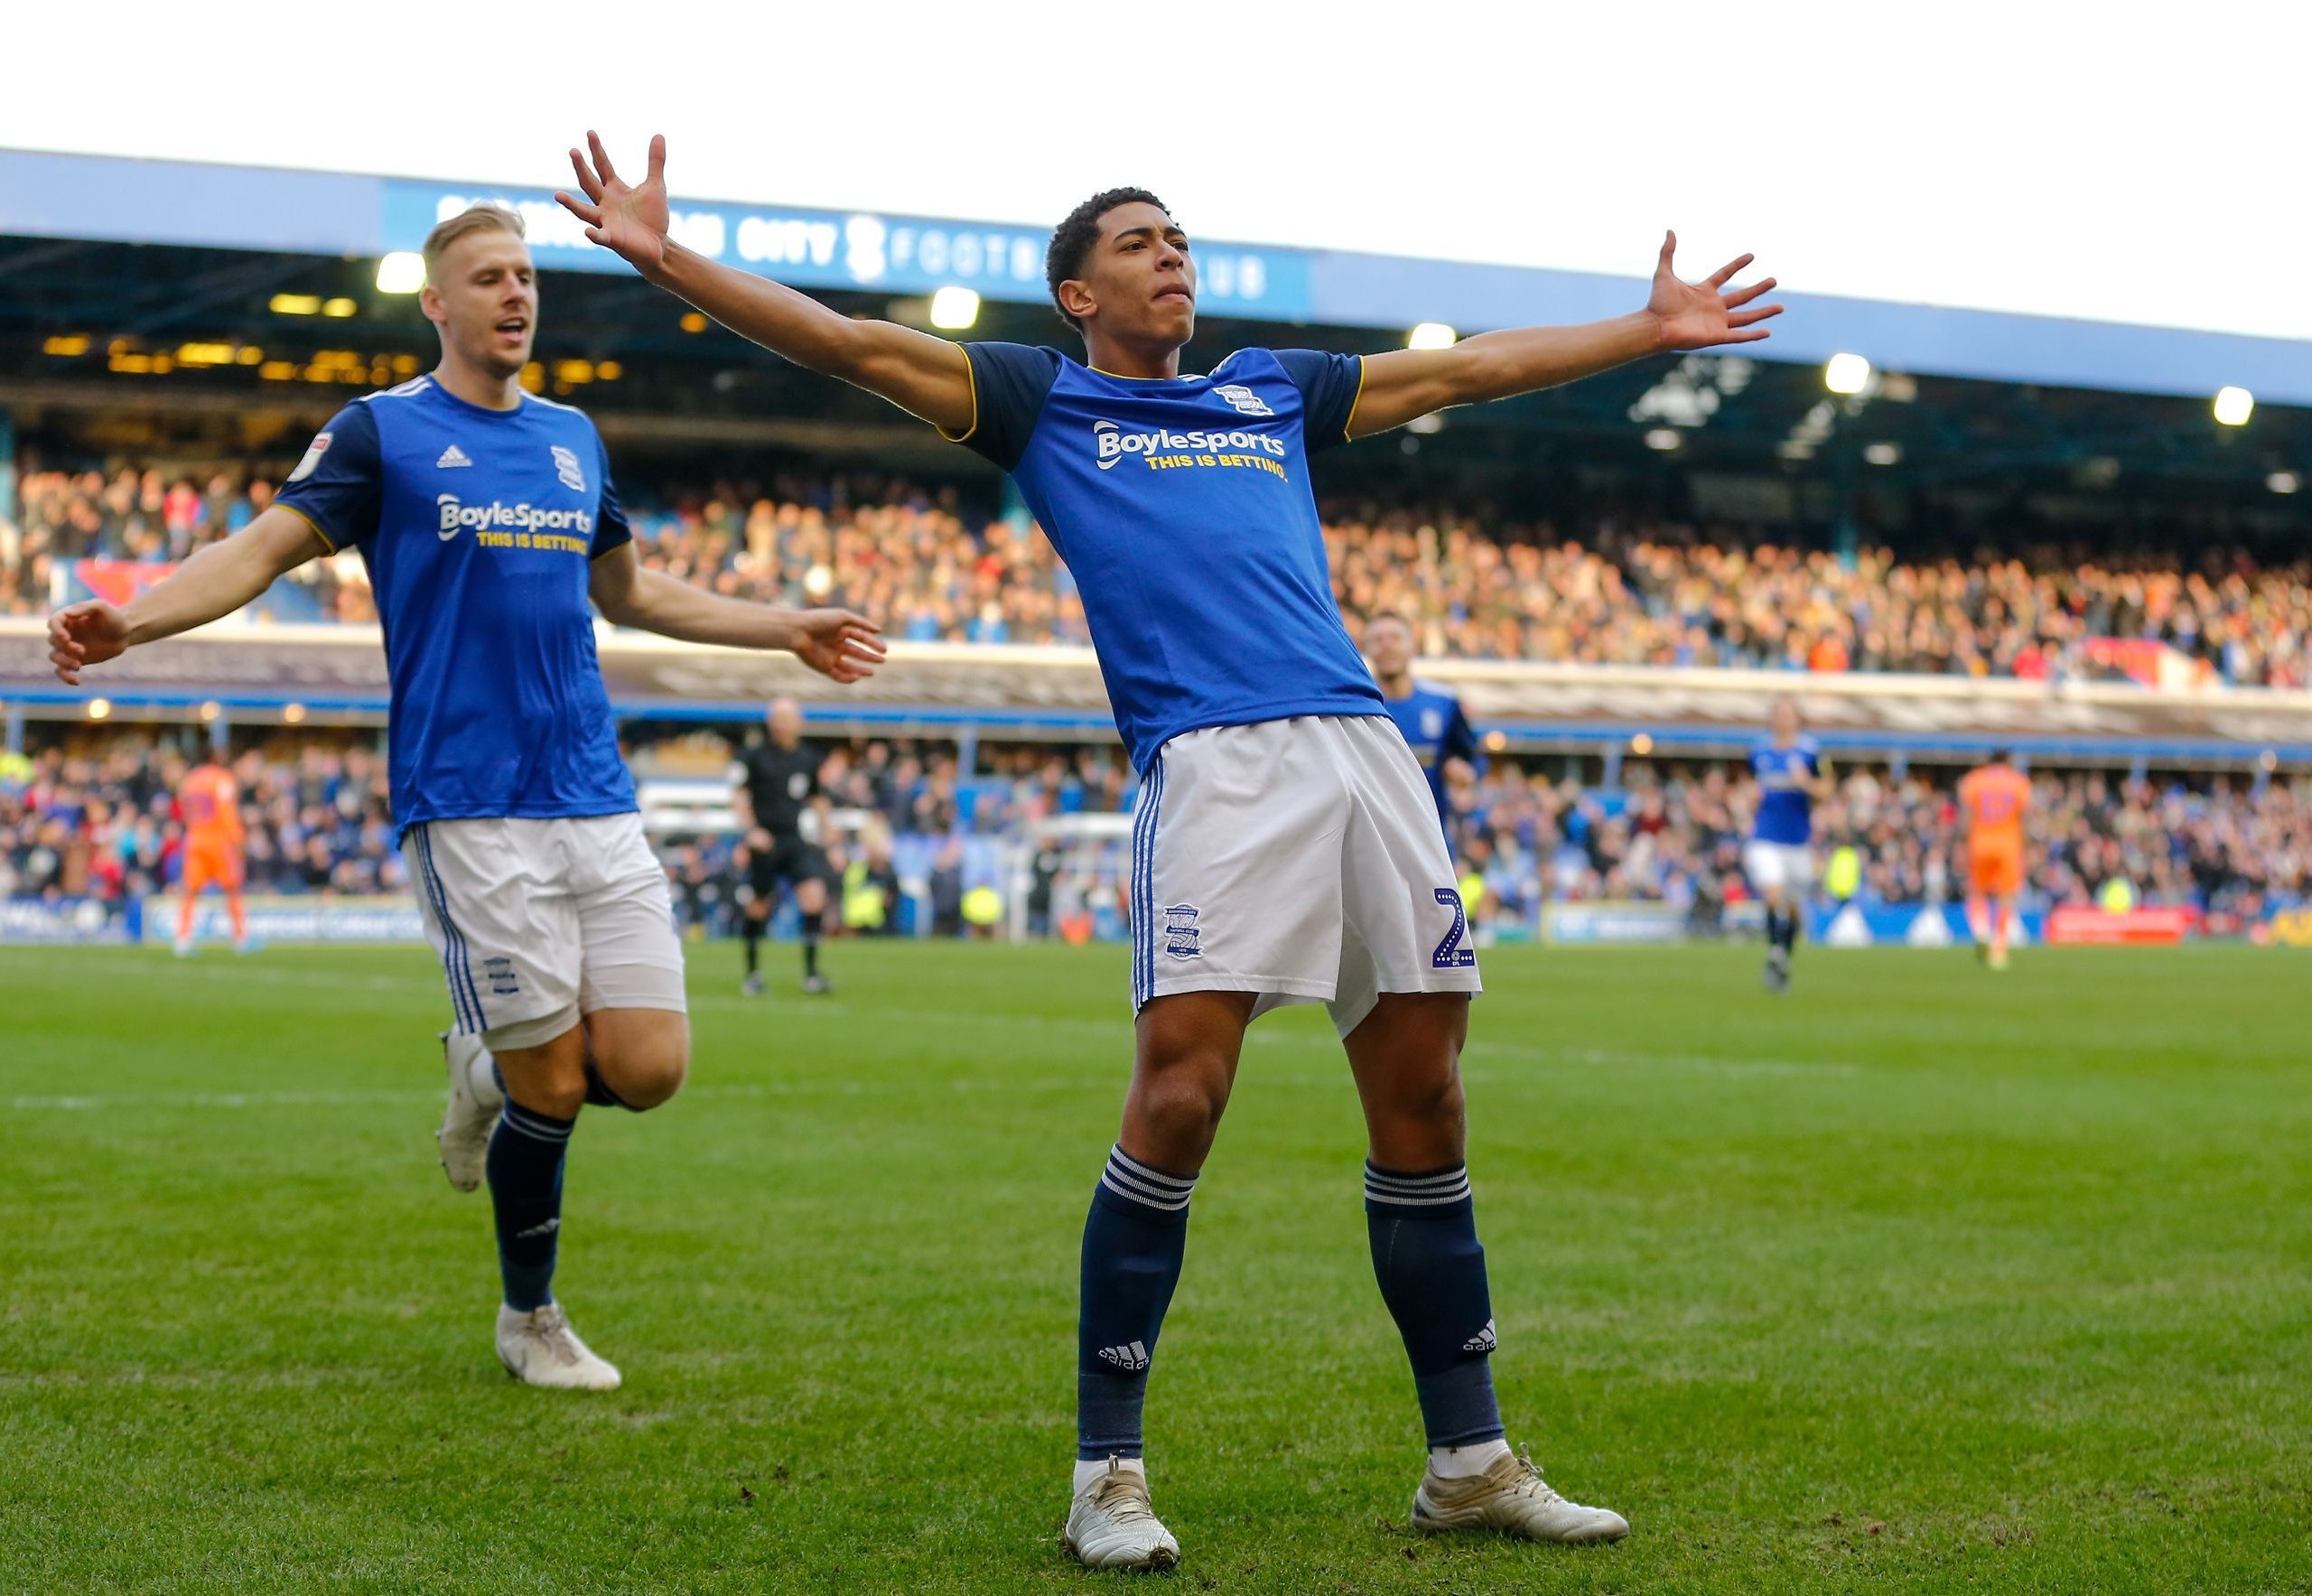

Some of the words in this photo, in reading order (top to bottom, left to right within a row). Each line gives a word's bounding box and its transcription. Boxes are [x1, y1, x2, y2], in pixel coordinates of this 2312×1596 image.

[890, 225, 1046, 283] FOOTB
[1097, 428, 1285, 456] BoyleSports
[1145, 455, 1194, 471] THIS
[1196, 454, 1216, 468] IS
[440, 501, 592, 533] BoyleSports
[476, 532, 513, 546] THIS
[516, 533, 530, 548] IS
[1433, 888, 1475, 967] 2
[1463, 1340, 1496, 1351] adid
